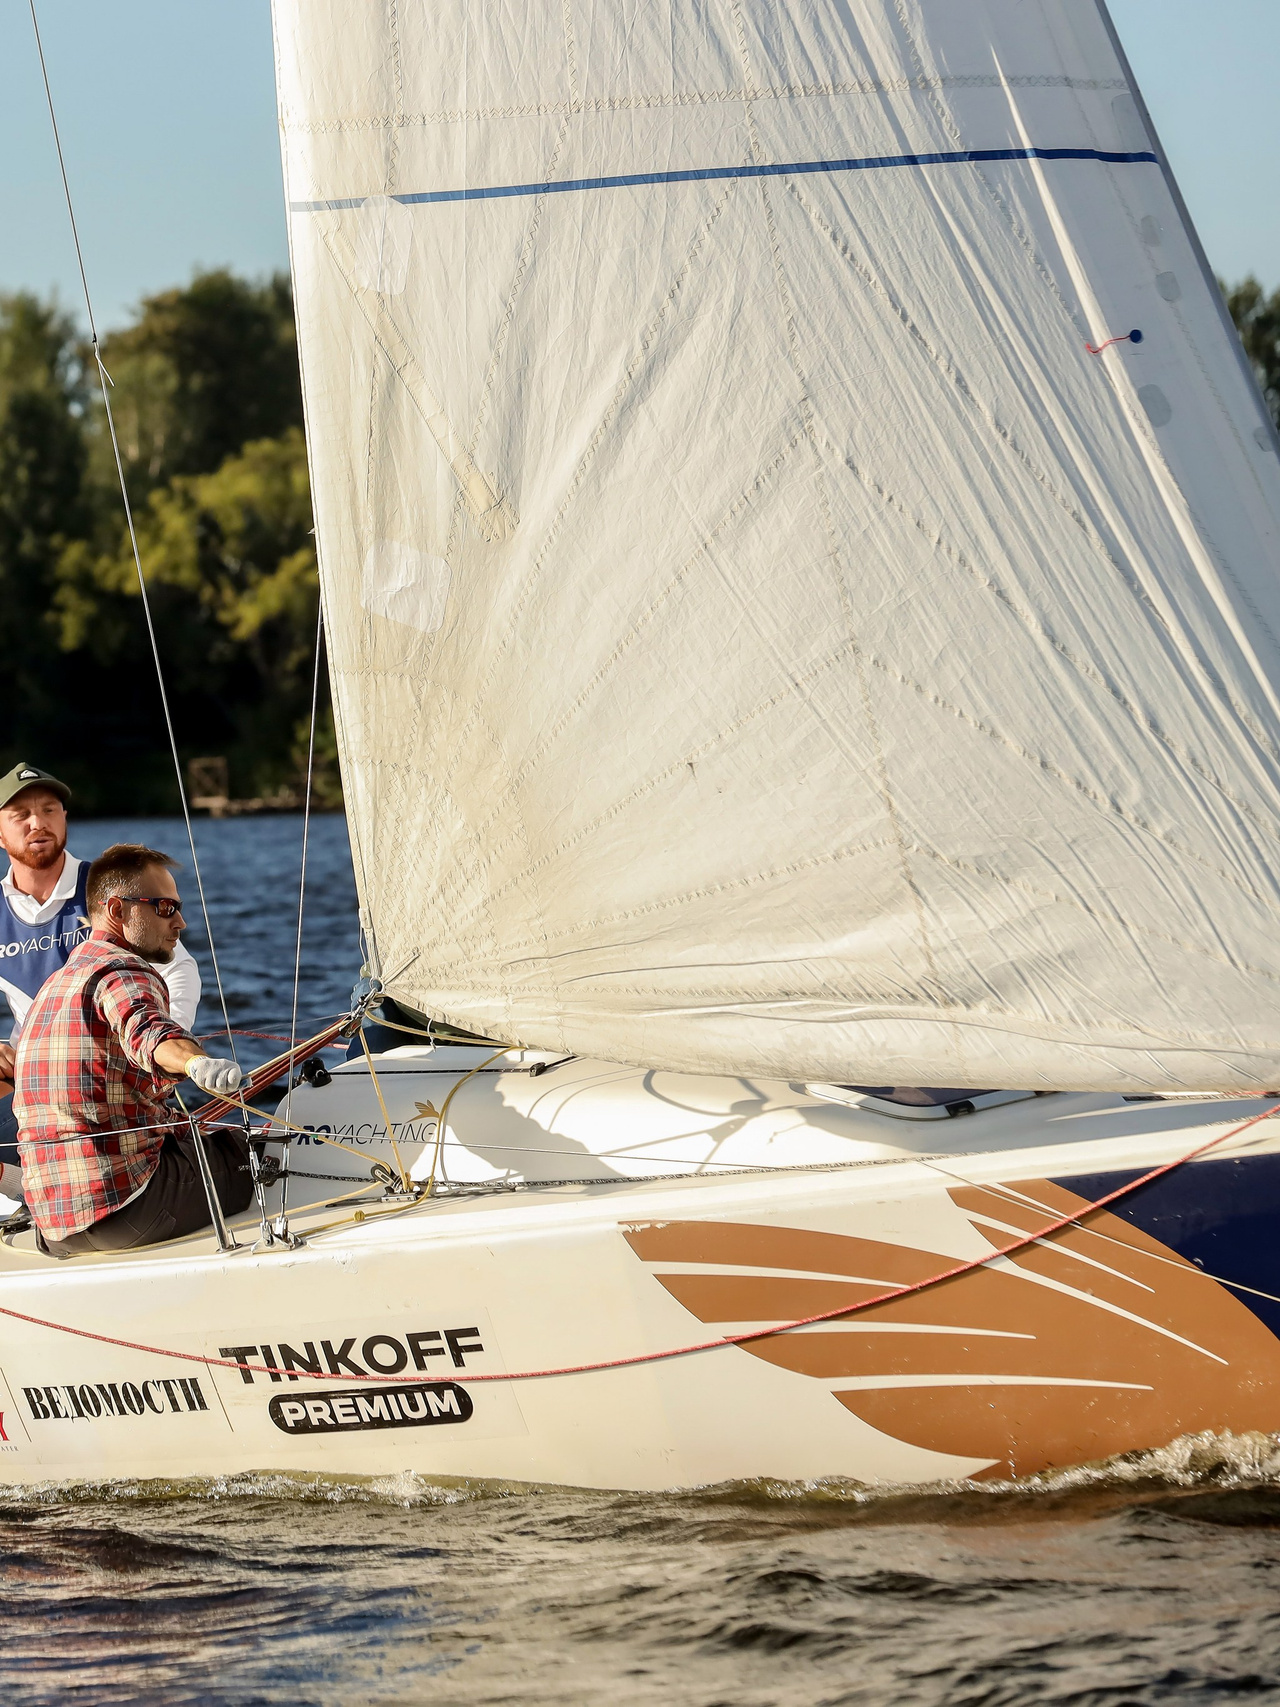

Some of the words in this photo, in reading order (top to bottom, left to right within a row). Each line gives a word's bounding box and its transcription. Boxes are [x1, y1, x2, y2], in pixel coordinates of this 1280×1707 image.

[219, 1327, 484, 1384] TINKOFF
[21, 1377, 210, 1422] ВЕДОМОСТИ
[279, 1389, 461, 1427] PREMIUM
